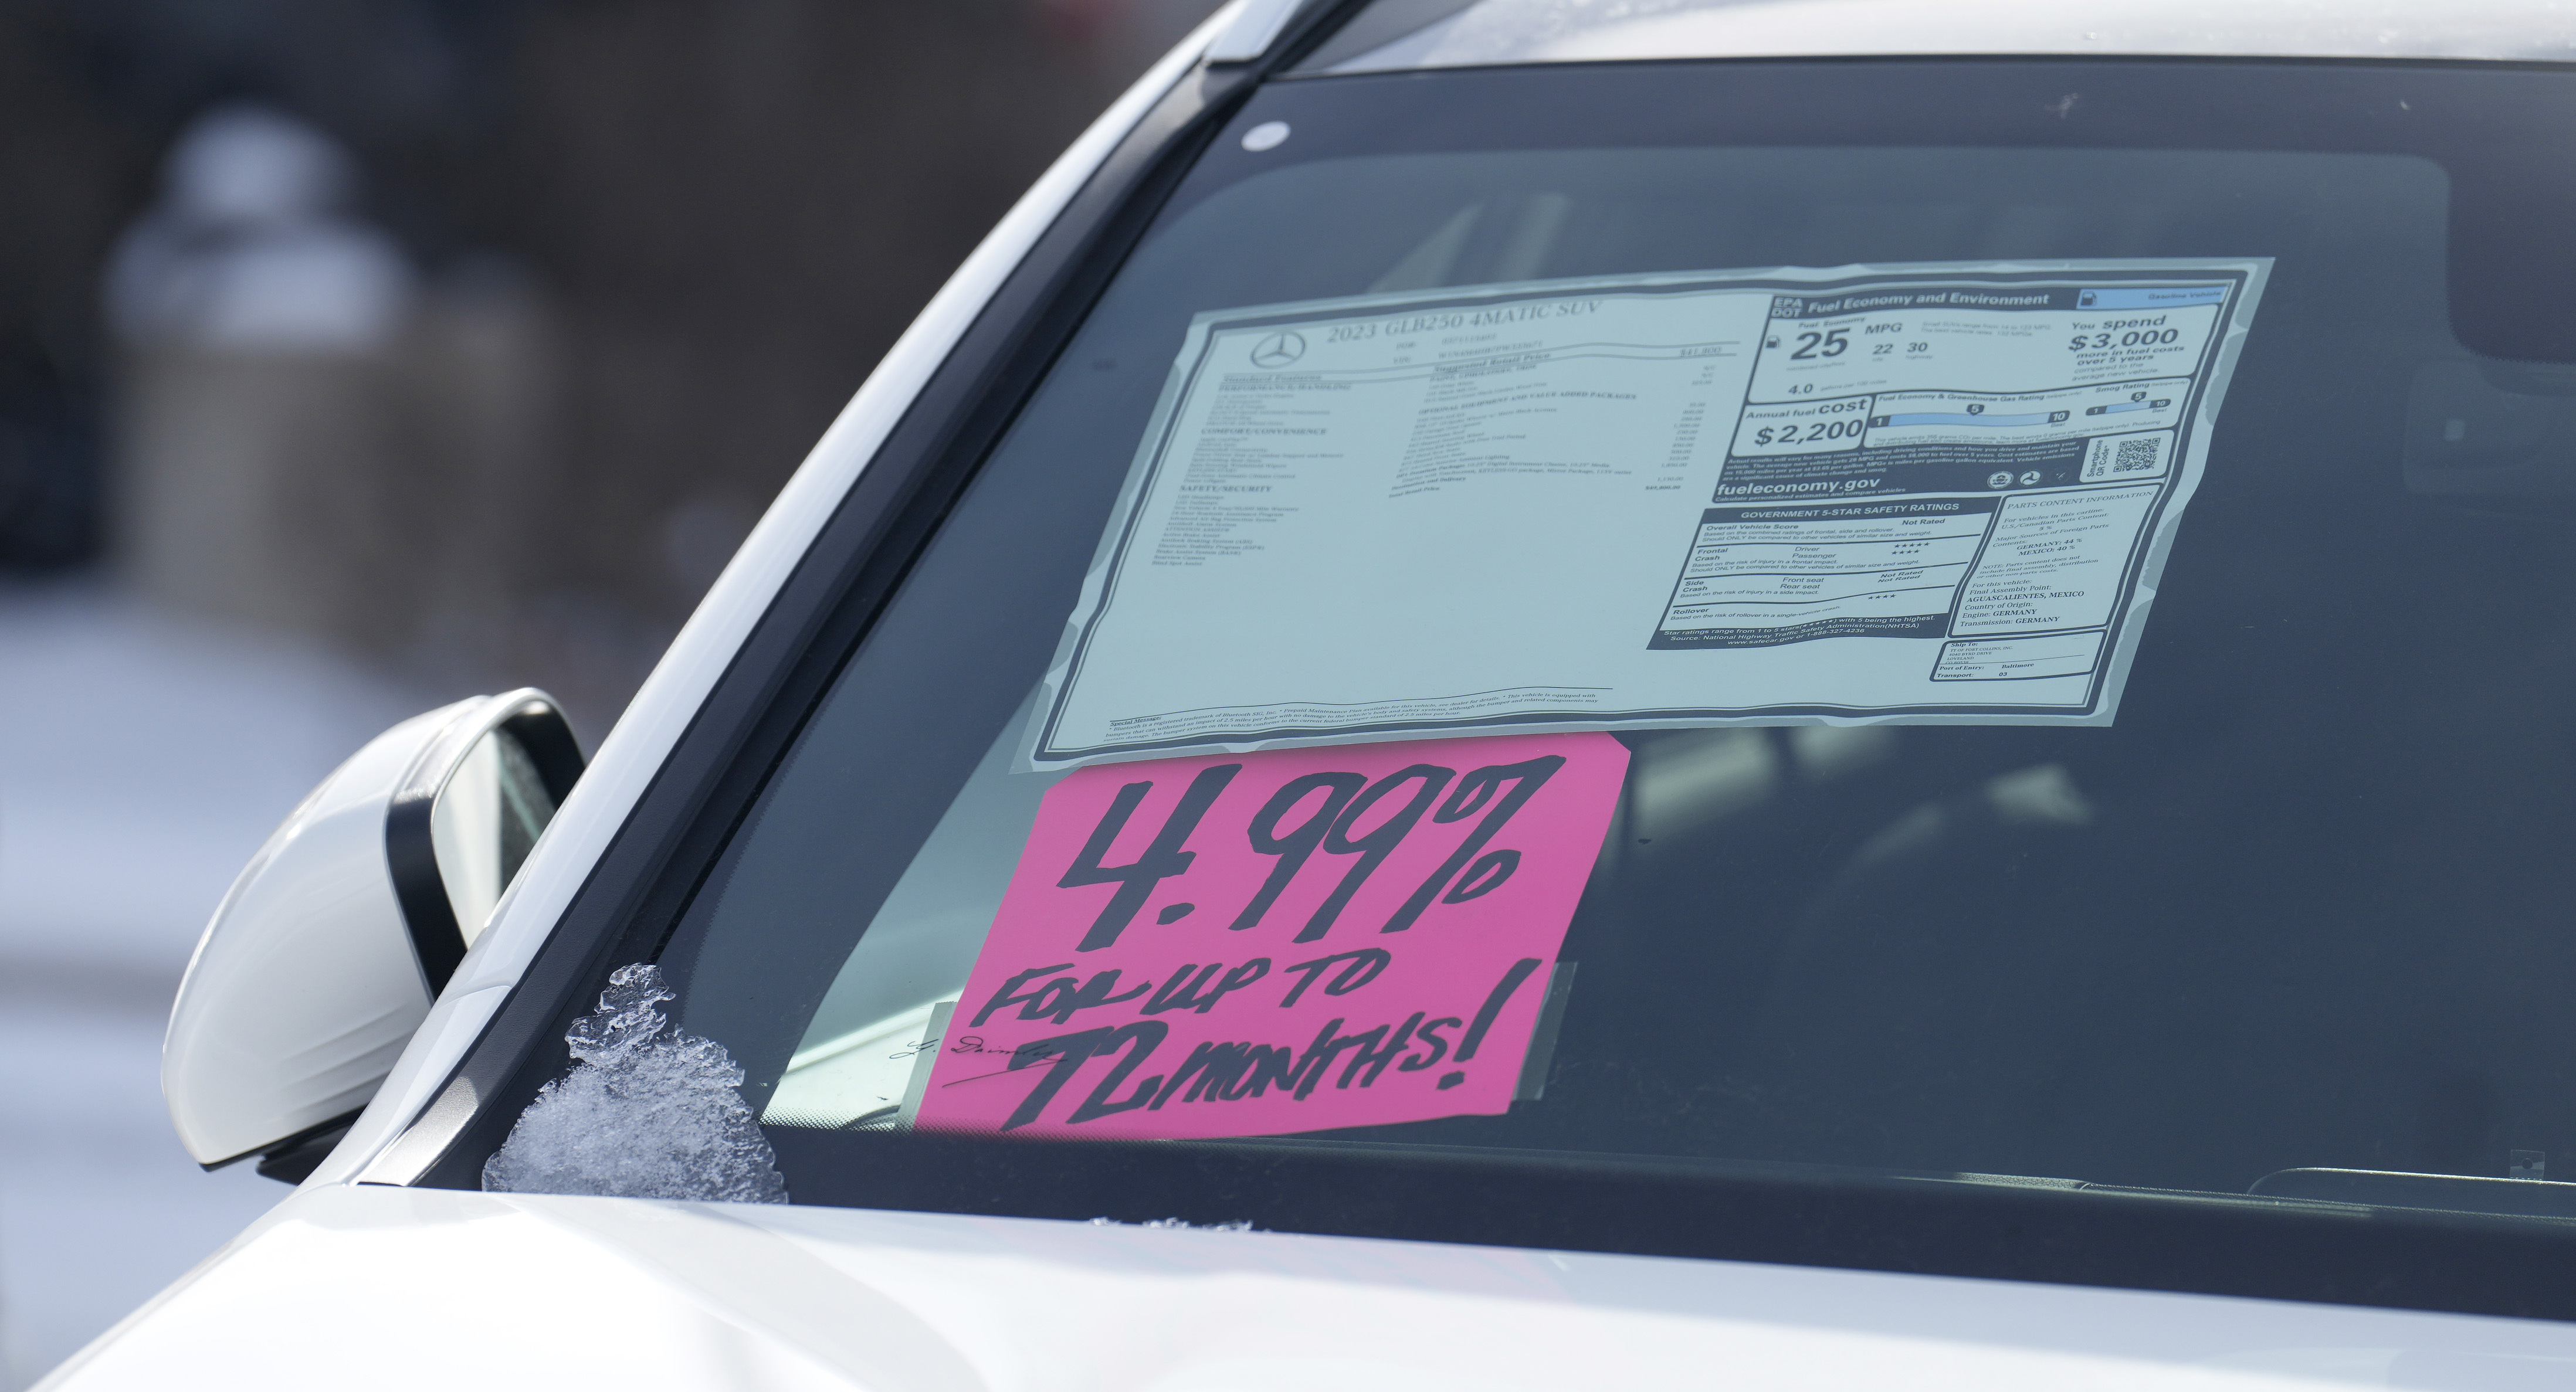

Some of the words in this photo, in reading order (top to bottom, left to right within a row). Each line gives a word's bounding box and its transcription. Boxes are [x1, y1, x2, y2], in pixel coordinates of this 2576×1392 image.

[1774, 297, 1802, 307] EPA
[1808, 300, 1841, 313] Fuel
[1843, 295, 1913, 310] Economy
[1916, 293, 1947, 304] and
[1949, 292, 2050, 305] Environment
[1771, 308, 1801, 318] DOT
[1327, 322, 1377, 343] 2023
[1385, 313, 1464, 337] GLB250
[1469, 304, 1551, 327] 4MATIC
[1555, 300, 1604, 317] SUV
[1823, 317, 1866, 327] Economy
[2102, 314, 2167, 330] spend
[1865, 323, 1903, 335] MPG
[1790, 327, 1850, 361] 25
[2069, 329, 2178, 352] $3,000
[1872, 343, 1893, 355] 22
[1907, 342, 1928, 352] 30
[2120, 355, 2154, 364] years
[2074, 364, 2116, 374] compared
[2072, 372, 2104, 381] average
[1788, 383, 1813, 395] 4.0
[2123, 382, 2150, 391] Rating
[1745, 411, 1789, 419] Annual
[1818, 399, 1867, 414] cost
[2053, 412, 2066, 421] 10
[1754, 420, 1863, 446] $2,200
[2087, 440, 2103, 477] Smartphone
[2096, 466, 2106, 476] QR
[1716, 478, 1882, 496] fueleconomy.gov
[1748, 493, 1793, 502] personalized
[1845, 489, 1875, 497] compare
[2006, 501, 2038, 510] PARTS
[2039, 498, 2084, 507] CONTENT
[2086, 490, 2154, 503] INFORMATION
[1741, 510, 1818, 519] GOVERNMENT
[1822, 507, 1861, 516] 5-STAR
[1864, 505, 1907, 514] SAFETY
[1910, 503, 1960, 512] RATINGS
[2001, 520, 2055, 530] U.S./Canadian
[2077, 512, 2109, 521] Content:
[2058, 527, 2087, 535] Foreign
[1992, 539, 2027, 548] Contents:
[2016, 541, 2062, 550] GERMANY:
[2018, 548, 2055, 556] MEXICO:
[1990, 586, 2028, 594] Assembly
[1967, 592, 2046, 602] AGUASCALIENTES,
[1964, 603, 1996, 611] Country
[2006, 600, 2033, 609] Origin:
[1962, 611, 1991, 619] Engine:
[1960, 619, 2014, 627] Transmission:
[2015, 616, 2060, 624] GERMANY
[1727, 634, 1794, 646] www.safecar.gov
[1806, 628, 1865, 637] 1-888-327-4236
[1134, 716, 1162, 724] Message:
[1056, 754, 1568, 953] 4.99%
[969, 962, 1153, 1028] FOR
[1140, 956, 1272, 1017] UP
[1280, 948, 1392, 1009] TO
[999, 1019, 1170, 1132] 72
[1154, 958, 1542, 1112] MONTHS!
